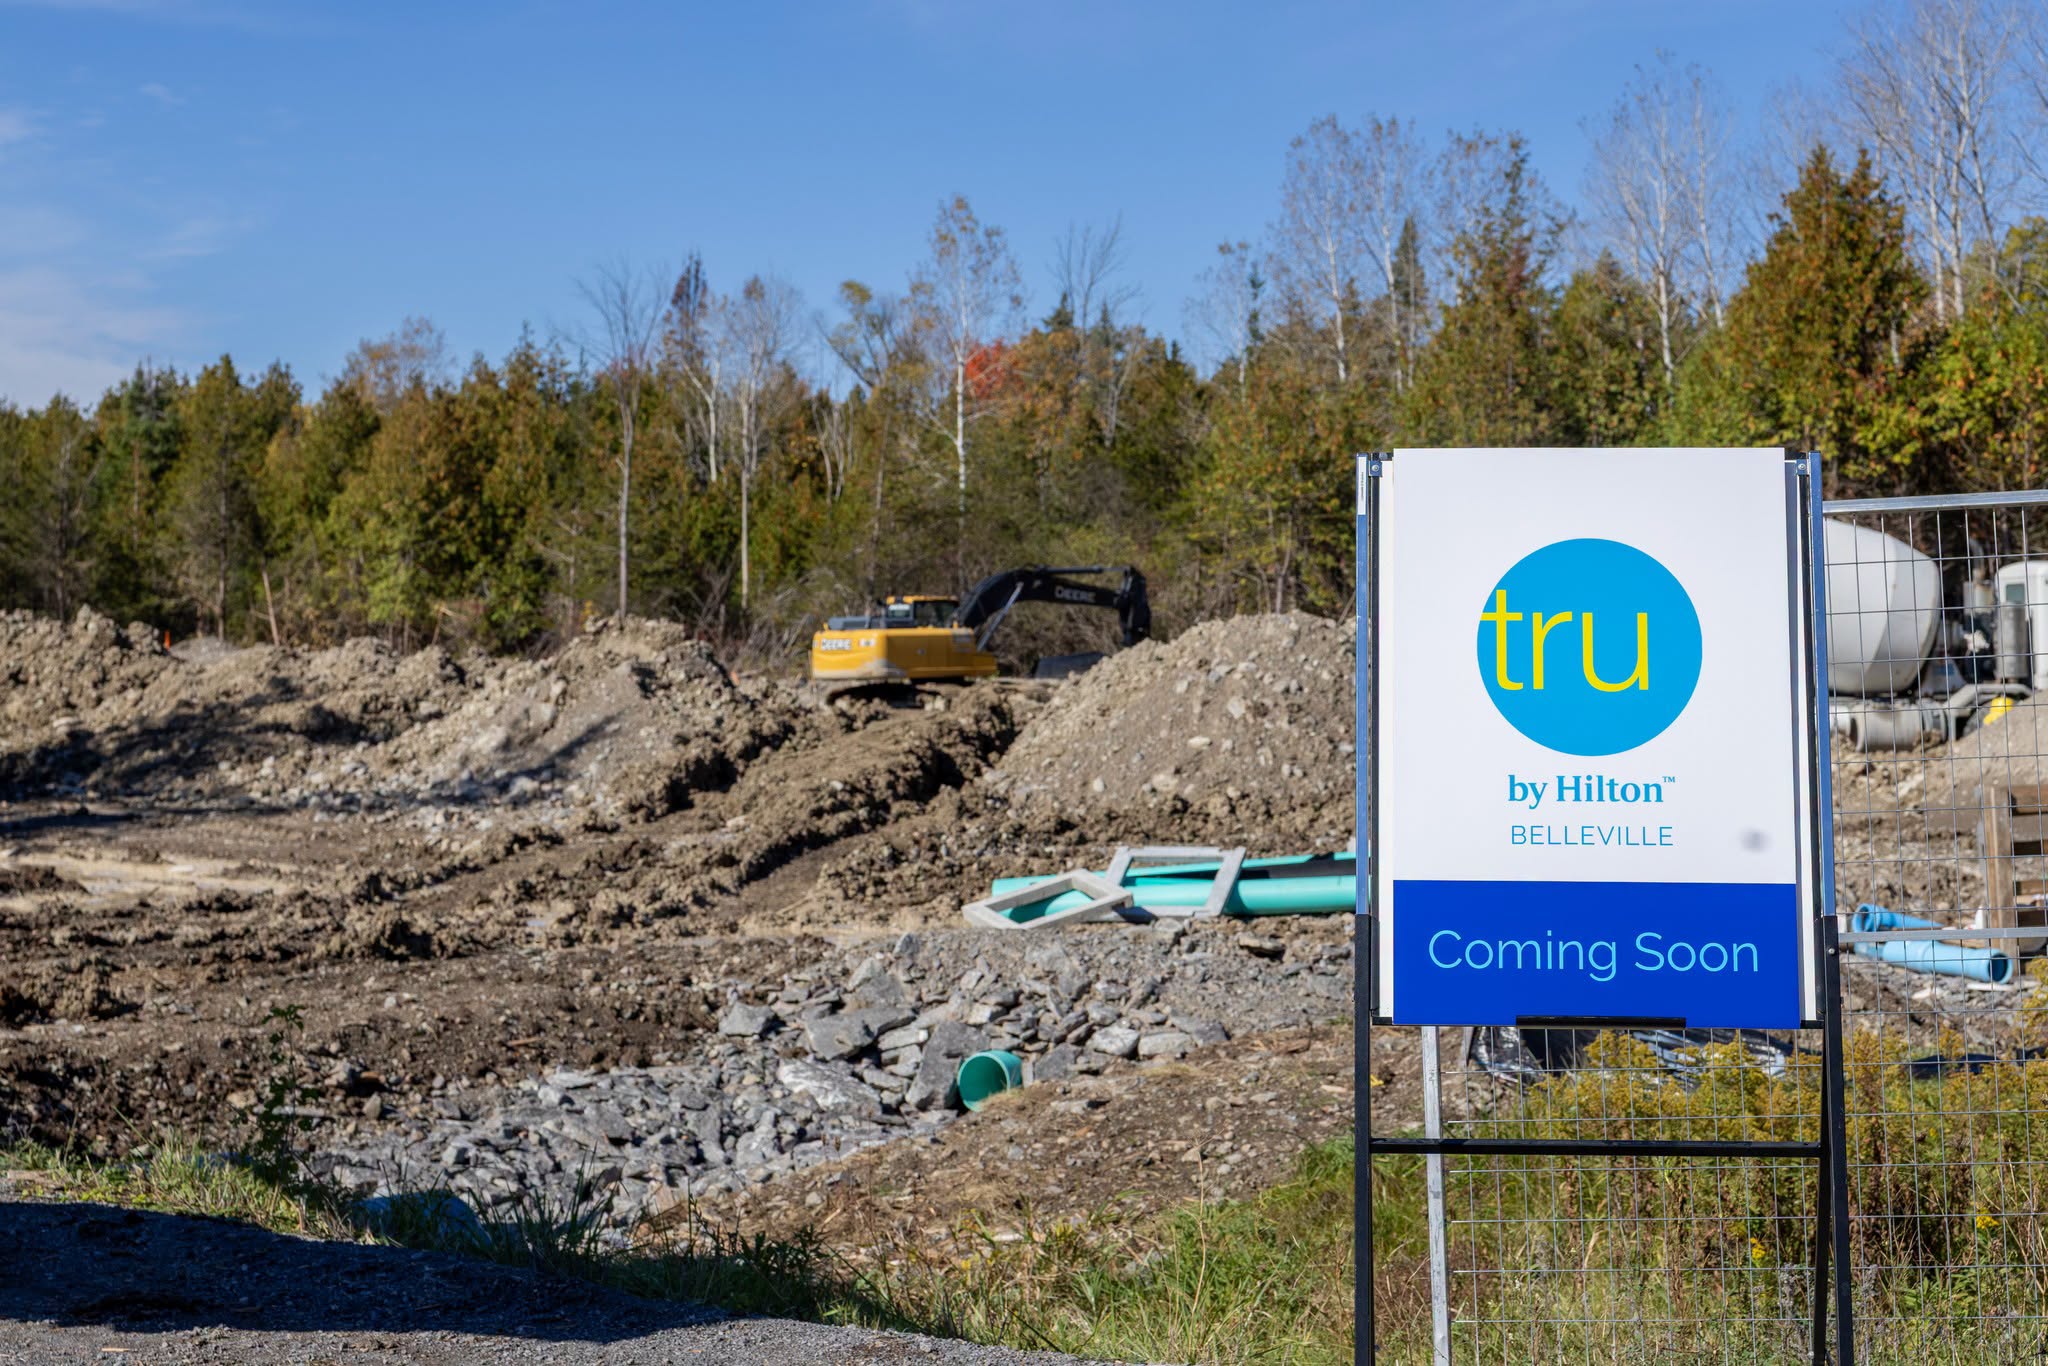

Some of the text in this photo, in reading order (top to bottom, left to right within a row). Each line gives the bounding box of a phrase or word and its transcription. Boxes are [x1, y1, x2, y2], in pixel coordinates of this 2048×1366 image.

[1054, 585, 1096, 603] DEERE
[821, 638, 852, 651] DEERE
[1480, 589, 1649, 693] tru
[1507, 774, 1548, 810] by
[1511, 824, 1674, 847] BELLEVILLE
[1428, 929, 1760, 982] Coming Soon
